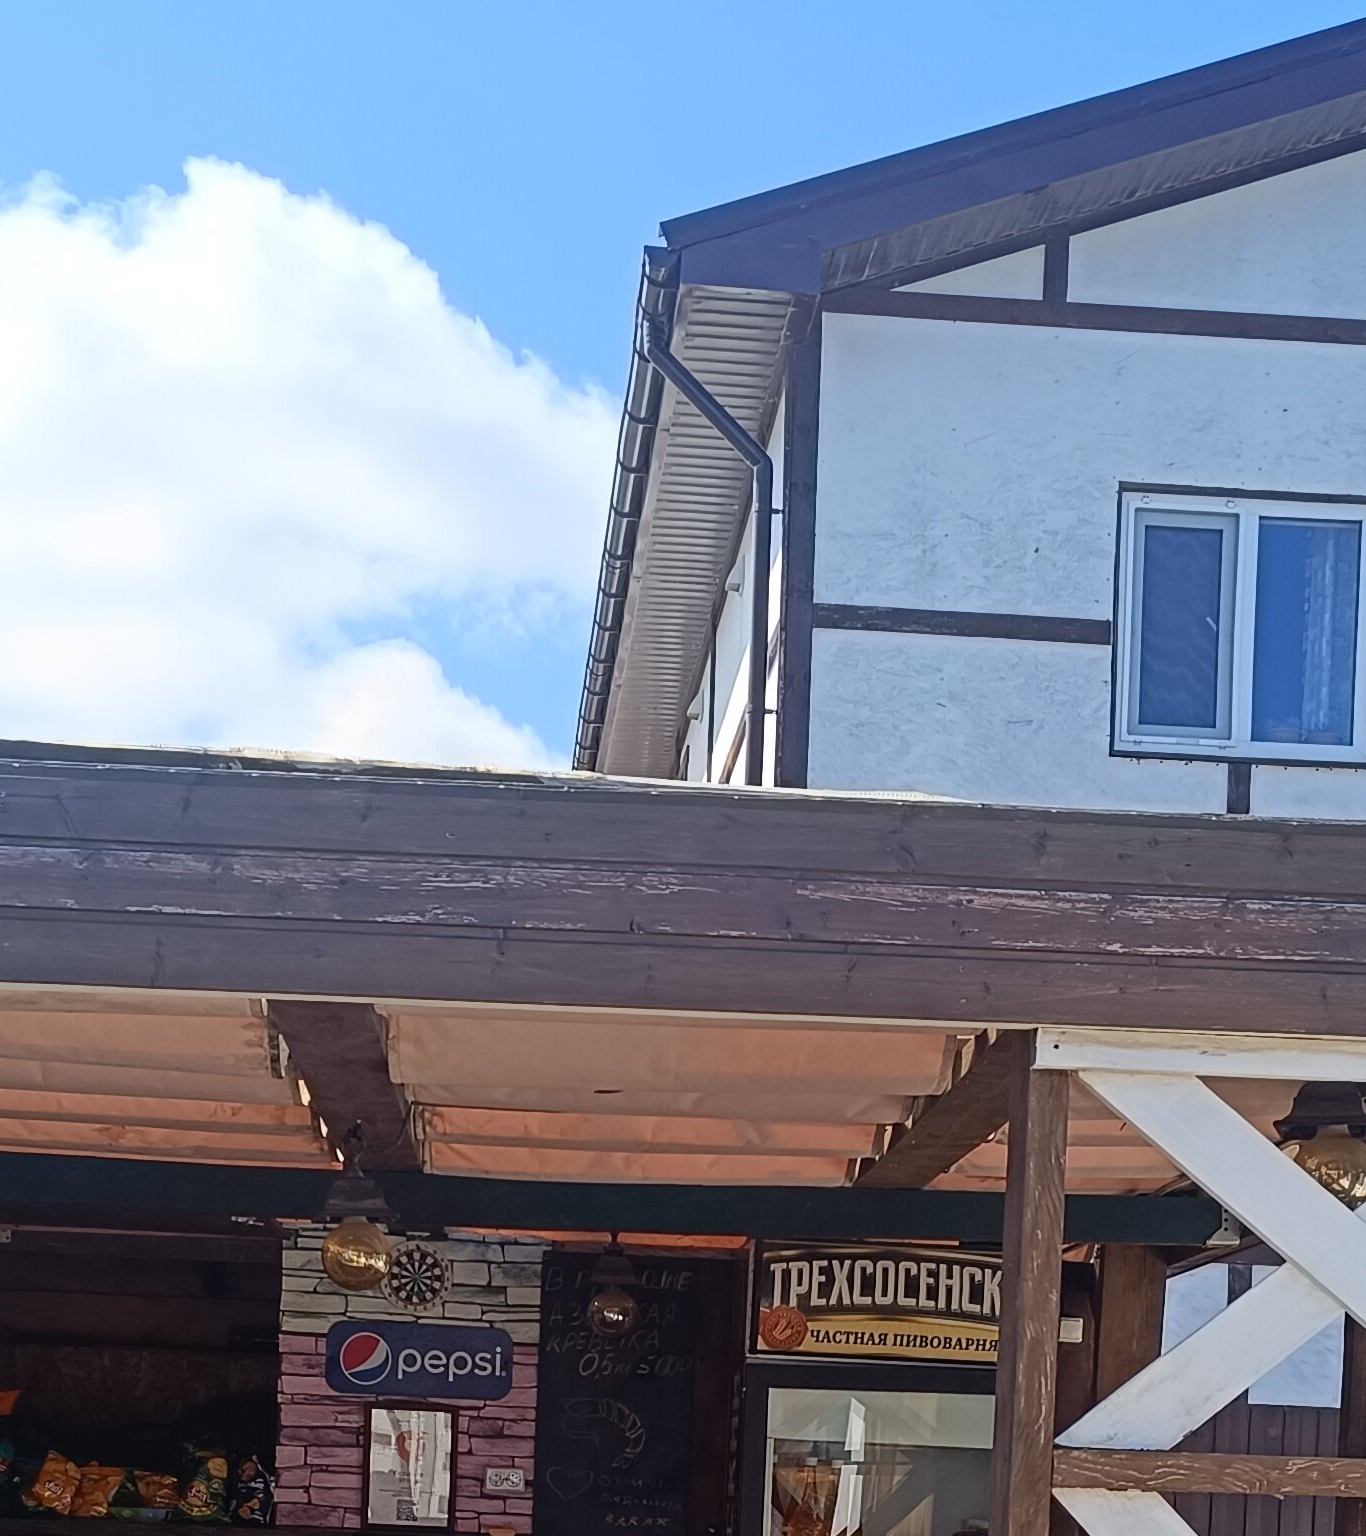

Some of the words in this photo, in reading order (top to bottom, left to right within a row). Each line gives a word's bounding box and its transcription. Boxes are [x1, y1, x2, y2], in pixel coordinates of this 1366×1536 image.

[809, 1329, 889, 1347] ЧАСТНАЯ
[891, 1333, 999, 1352] ПИВОВАРНЯ
[397, 1346, 503, 1382] pepsi
